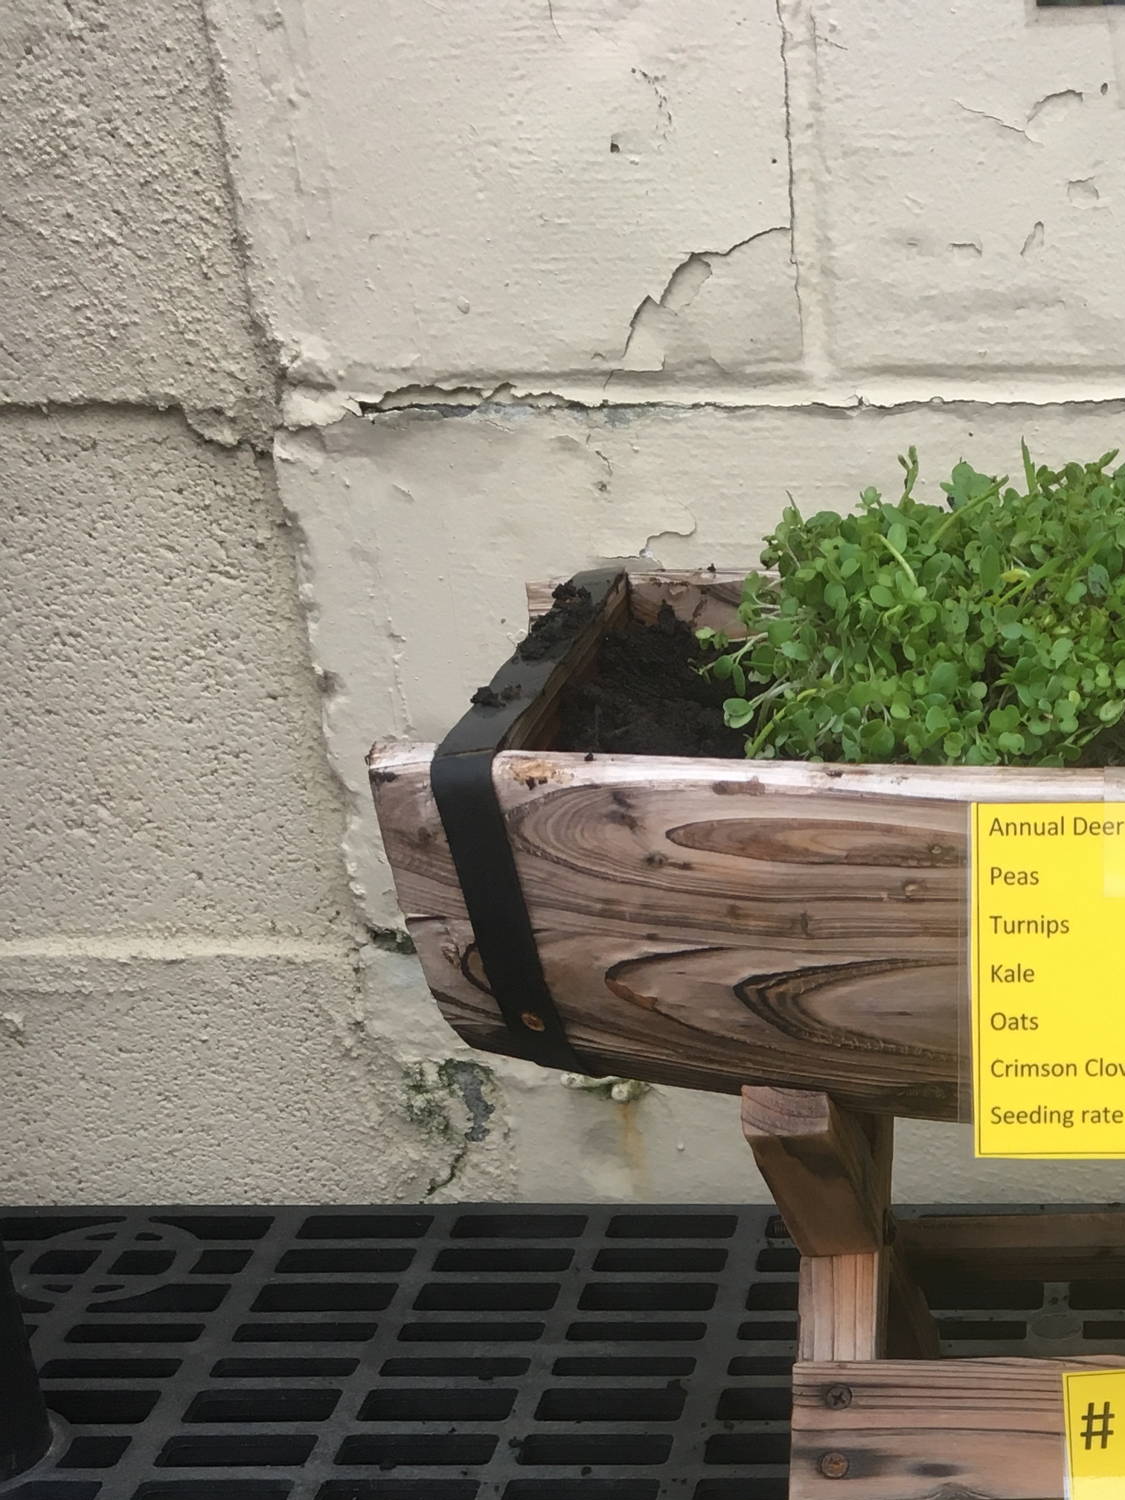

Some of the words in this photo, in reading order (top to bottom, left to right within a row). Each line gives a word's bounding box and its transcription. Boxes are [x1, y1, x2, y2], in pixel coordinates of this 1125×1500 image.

[989, 815, 1066, 837] Annual
[1073, 816, 1125, 837] Deer
[990, 866, 1040, 886] Peas
[990, 914, 1070, 938] Turnips
[990, 963, 1035, 983] Kale
[990, 1012, 1039, 1032] Oats
[990, 1058, 1078, 1079] Crimson
[990, 1104, 1074, 1130] Seeding
[1081, 1107, 1124, 1125] rate
[1080, 1401, 1115, 1450] #
